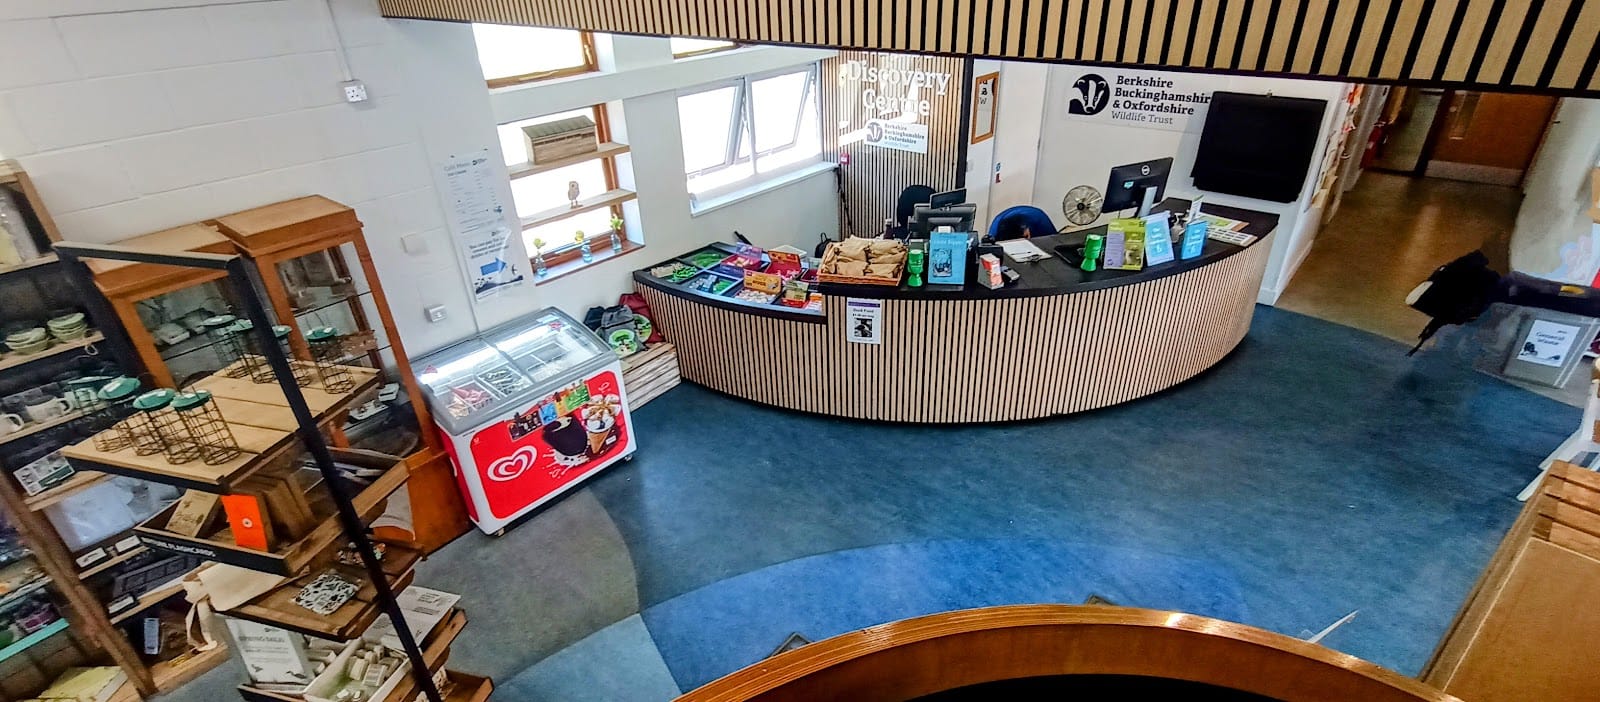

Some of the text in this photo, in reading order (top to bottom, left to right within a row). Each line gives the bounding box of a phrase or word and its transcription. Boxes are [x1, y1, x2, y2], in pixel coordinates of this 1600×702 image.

[847, 59, 952, 95] Discovery
[1116, 75, 1174, 88] Berkshire
[862, 88, 930, 116] Centre
[1114, 87, 1212, 105] Buckinghamshir
[1112, 100, 1195, 116] & Oxfordshire
[1111, 111, 1173, 125] Wildlife Trust
